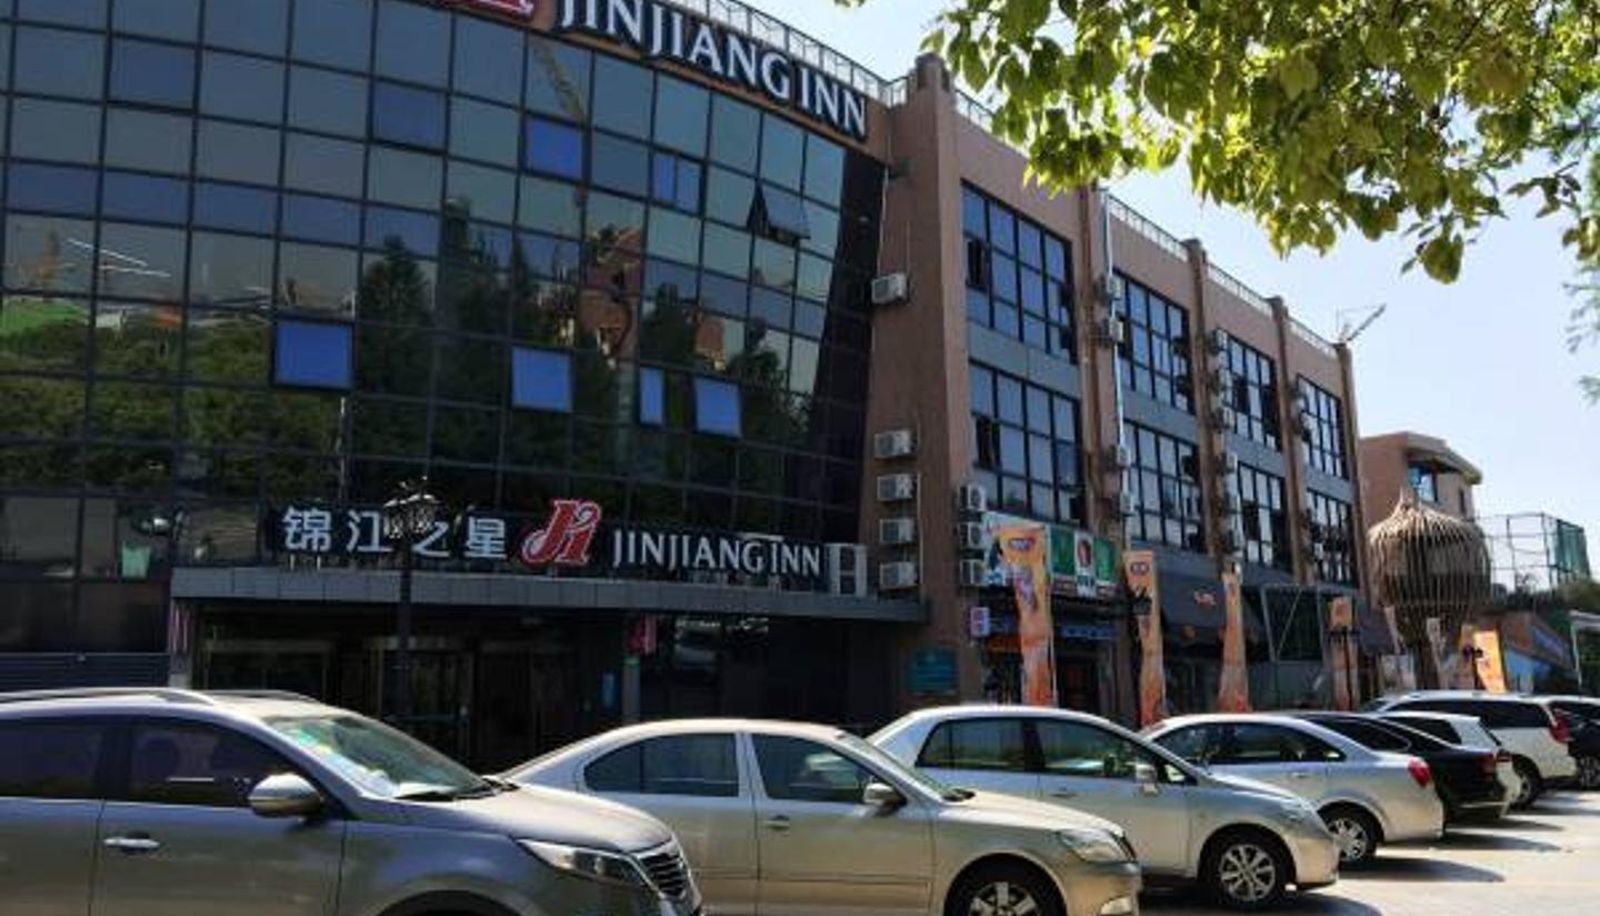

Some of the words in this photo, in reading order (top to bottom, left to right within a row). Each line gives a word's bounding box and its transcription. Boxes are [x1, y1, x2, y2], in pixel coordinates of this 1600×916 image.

[561, 0, 791, 99] JINJIANG
[801, 68, 866, 136] INN
[282, 505, 507, 558] 锦江之星
[612, 529, 763, 574] JINJIANG
[770, 542, 820, 576] INN
